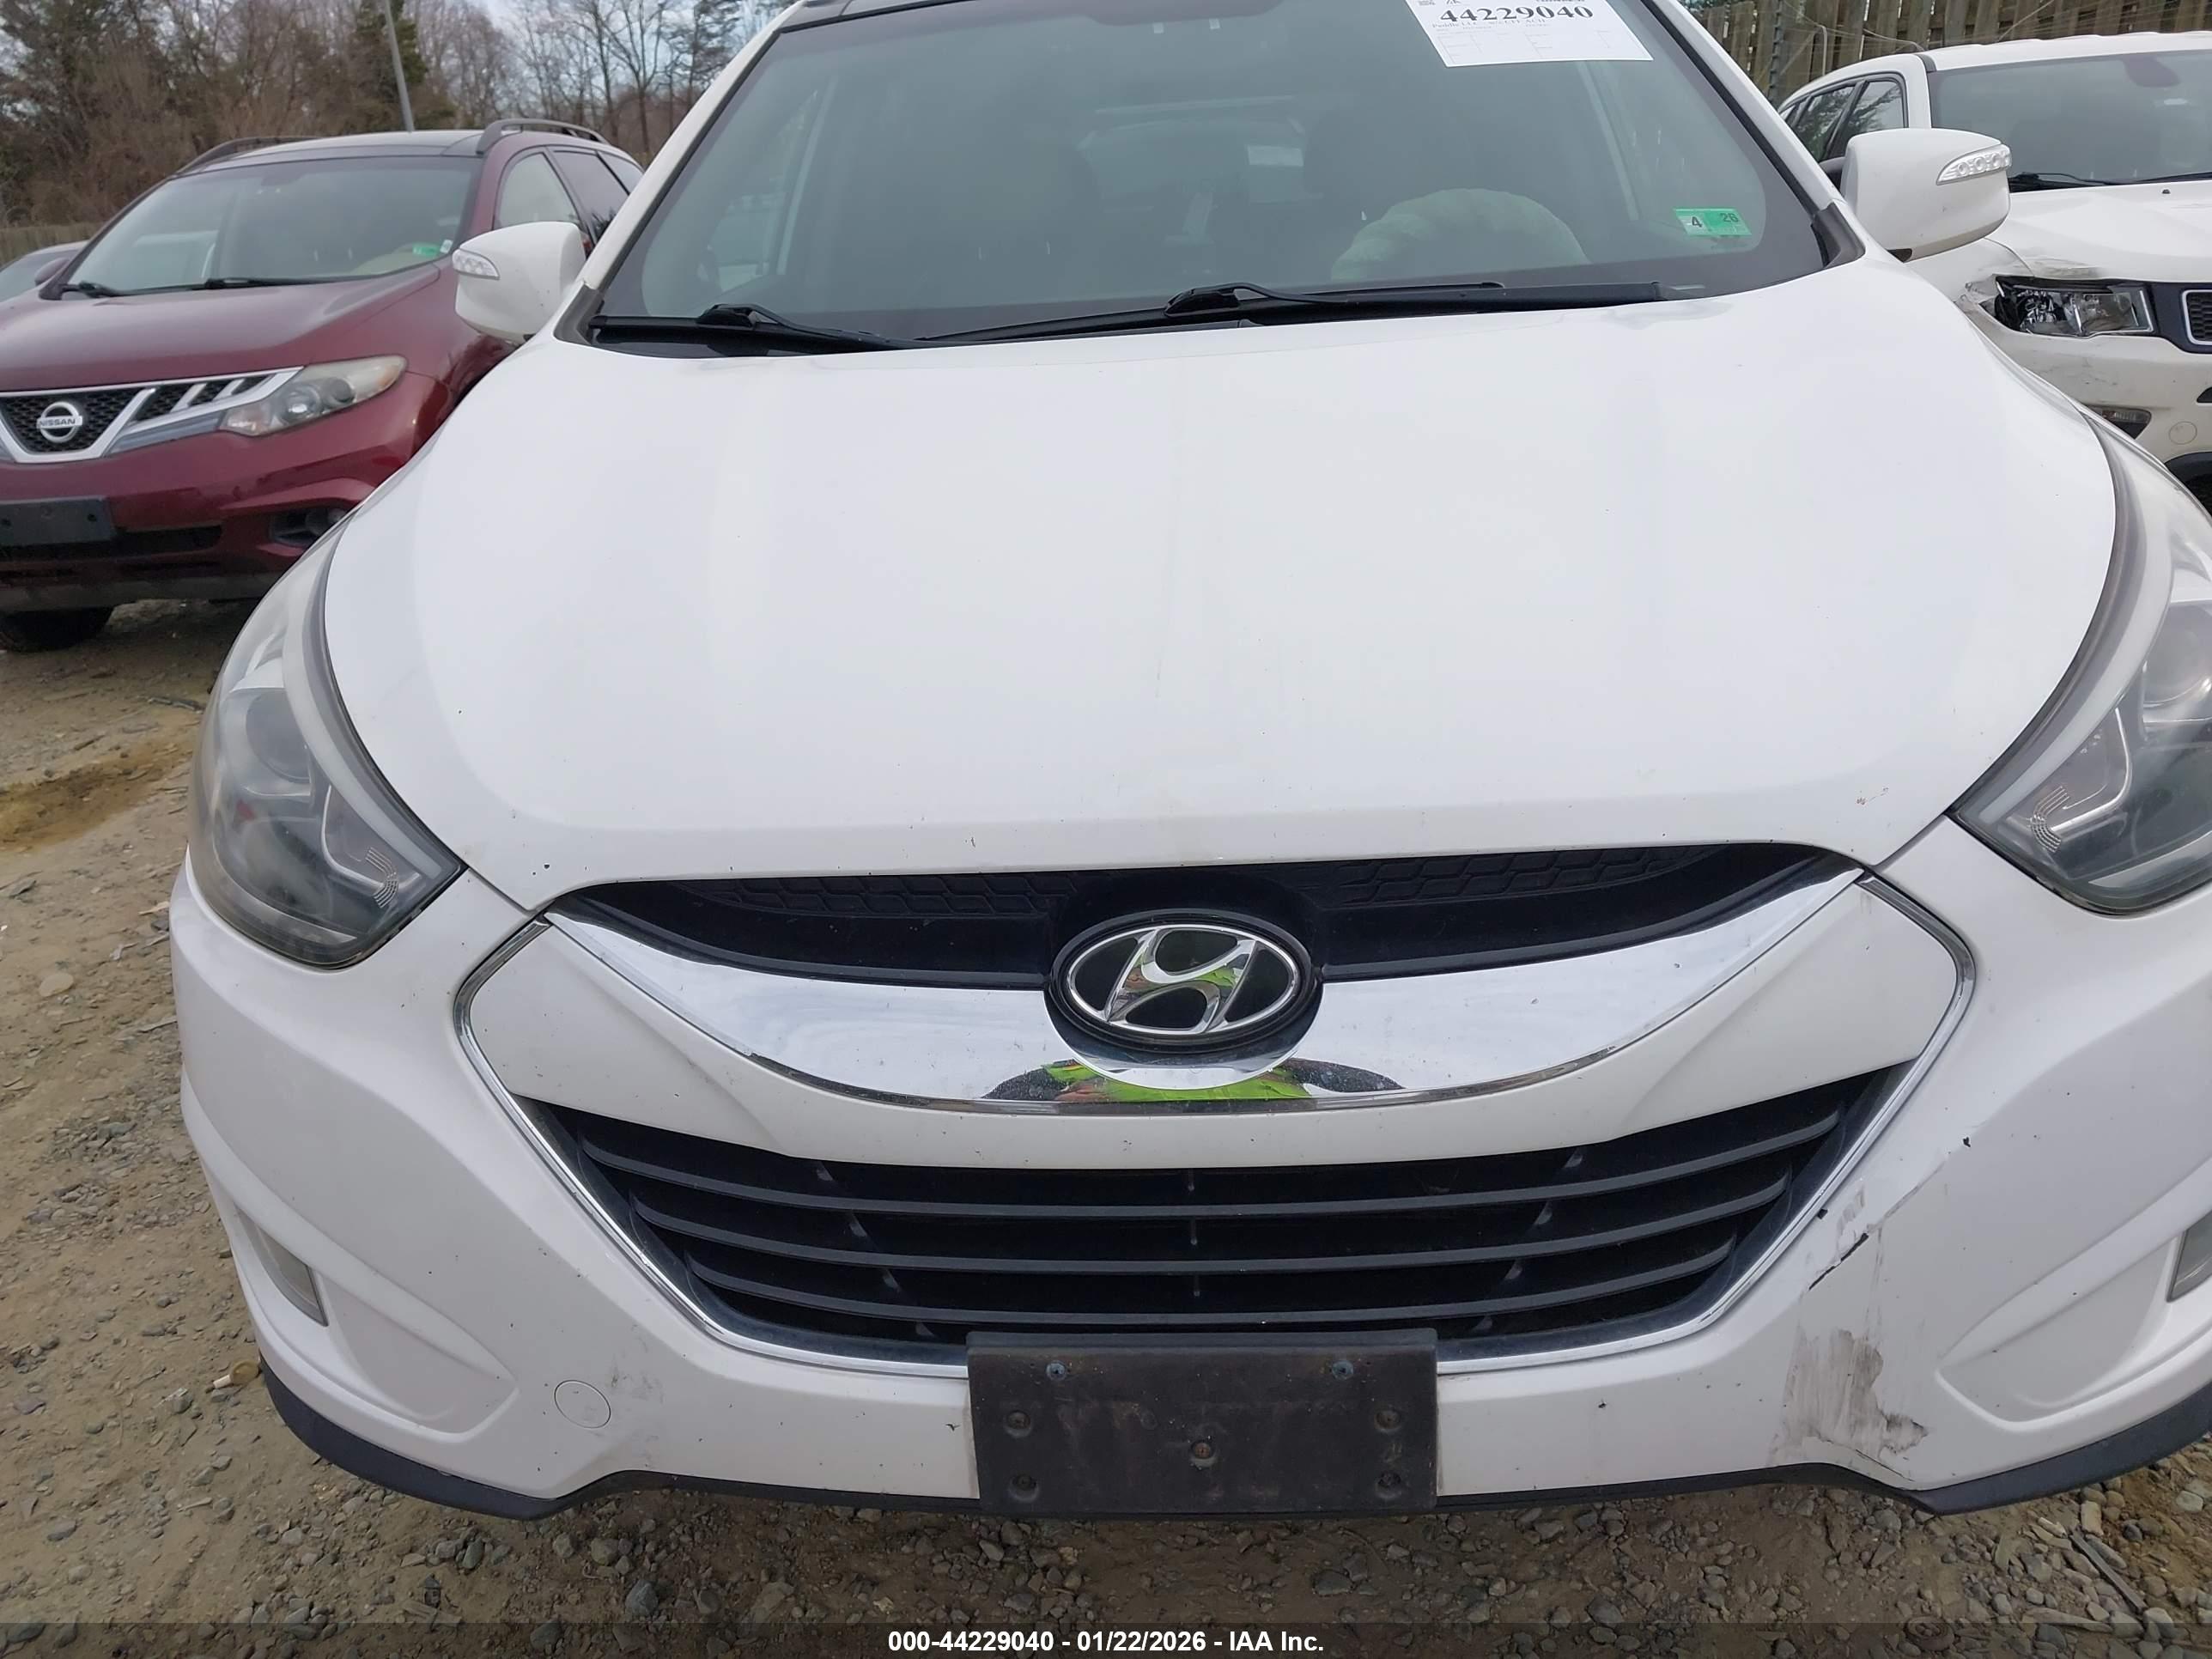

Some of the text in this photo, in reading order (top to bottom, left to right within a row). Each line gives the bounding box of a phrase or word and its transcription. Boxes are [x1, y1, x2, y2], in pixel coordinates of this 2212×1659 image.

[1440, 5, 1594, 22] 44229040
[1692, 216, 1703, 228] 4
[1720, 212, 1740, 222] 26
[40, 418, 76, 427] NISSAN
